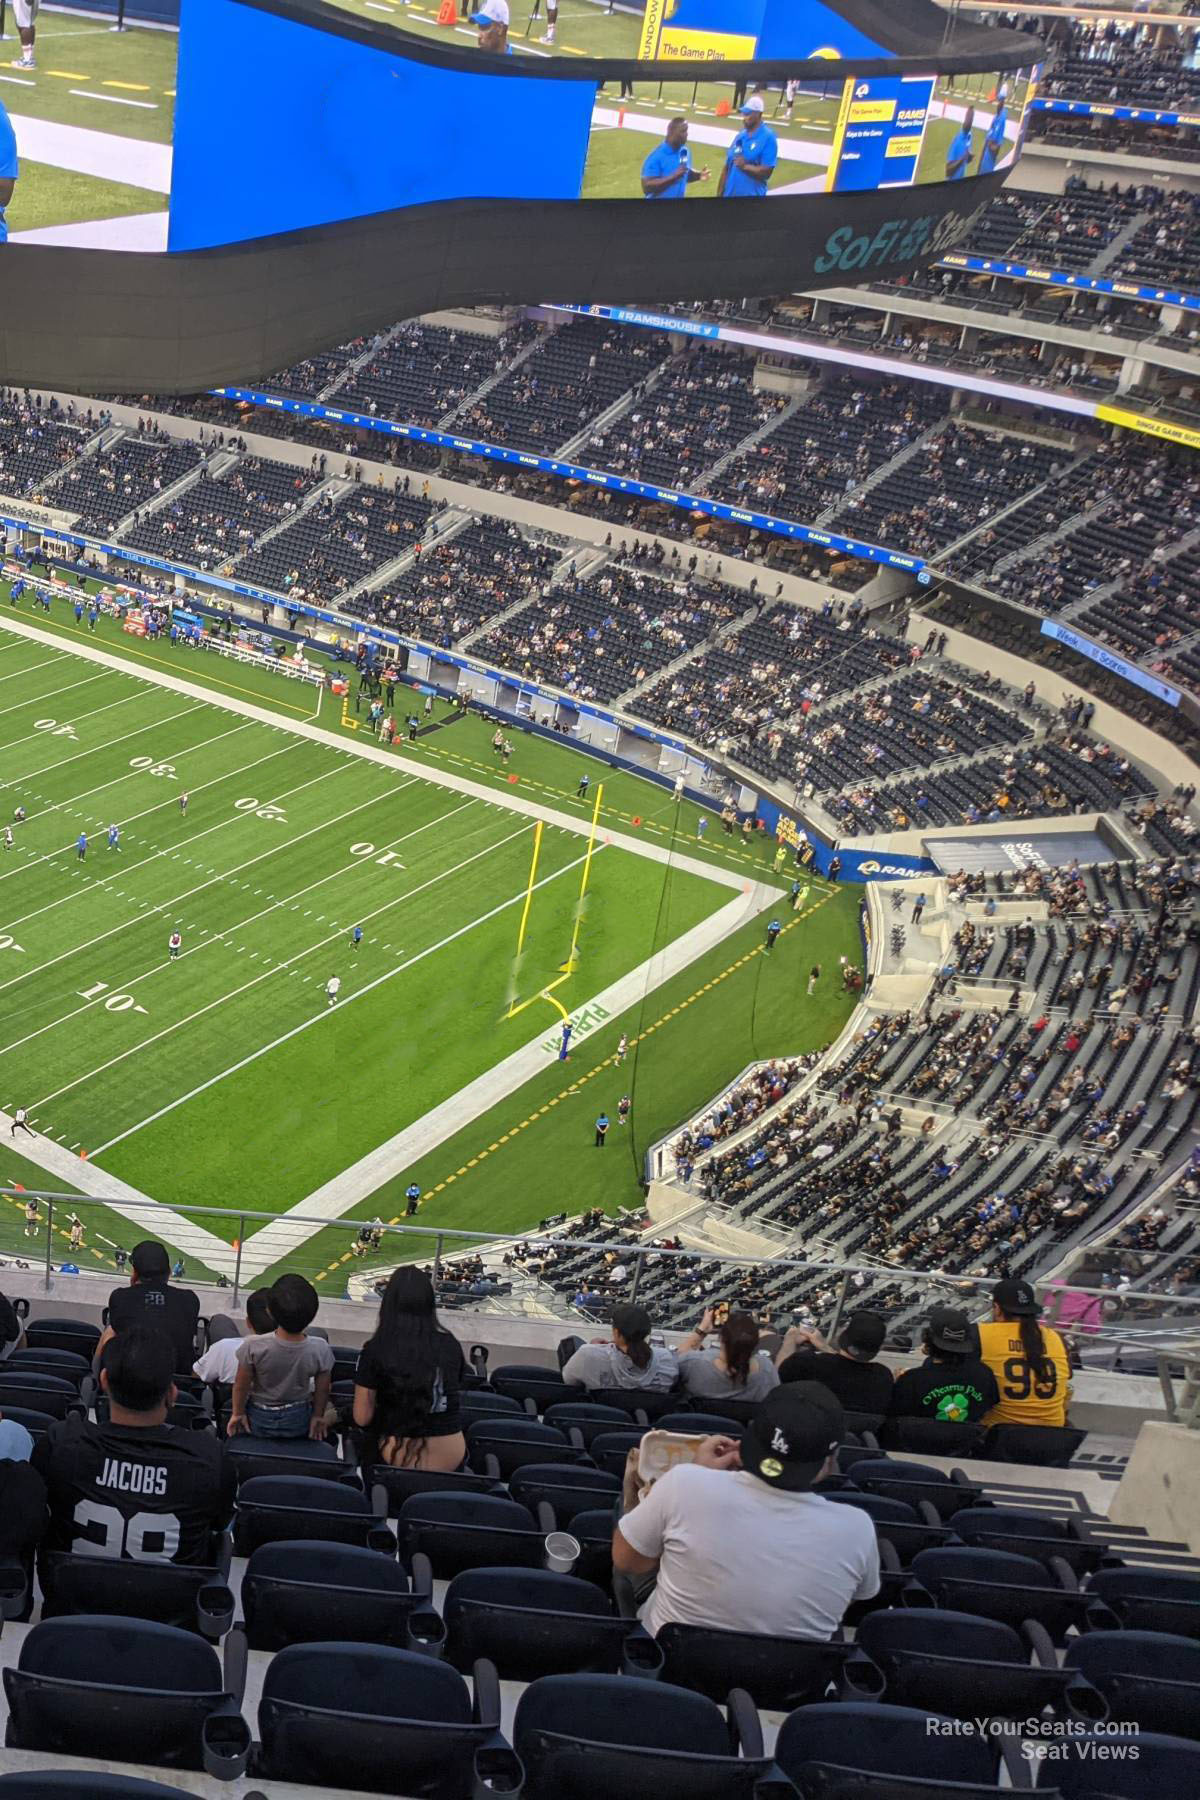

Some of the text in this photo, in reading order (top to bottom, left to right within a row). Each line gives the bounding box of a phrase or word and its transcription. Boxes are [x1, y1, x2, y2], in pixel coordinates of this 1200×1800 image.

[663, 43, 678, 55] The
[680, 46, 704, 59] Game
[897, 108, 926, 120] RAMS
[814, 219, 908, 273] SoFi
[943, 255, 967, 266] RAMS
[1026, 268, 1050, 279] RAMS
[1112, 284, 1139, 295] RAMS
[618, 310, 702, 335] #RAMSHOUSE
[266, 398, 283, 407] RAMS
[325, 411, 342, 419] RAMS
[391, 425, 409, 434] RAMS
[454, 440, 473, 449] RAMS
[519, 456, 539, 465] RAMS
[587, 473, 607, 483] RAMS
[657, 491, 678, 502] RAMS
[730, 511, 752, 522] RAMS
[808, 532, 831, 543] RAMS
[889, 555, 914, 567] RAMS
[34, 718, 75, 736] 40
[129, 756, 176, 776] 30
[234, 797, 288, 819] 20
[350, 842, 403, 865] 10
[881, 865, 935, 878] RAMS
[76, 981, 135, 1011] 10
[1004, 1358, 1056, 1399] 99
[965, 1383, 983, 1402] Pub
[95, 1458, 168, 1495] JACOBS
